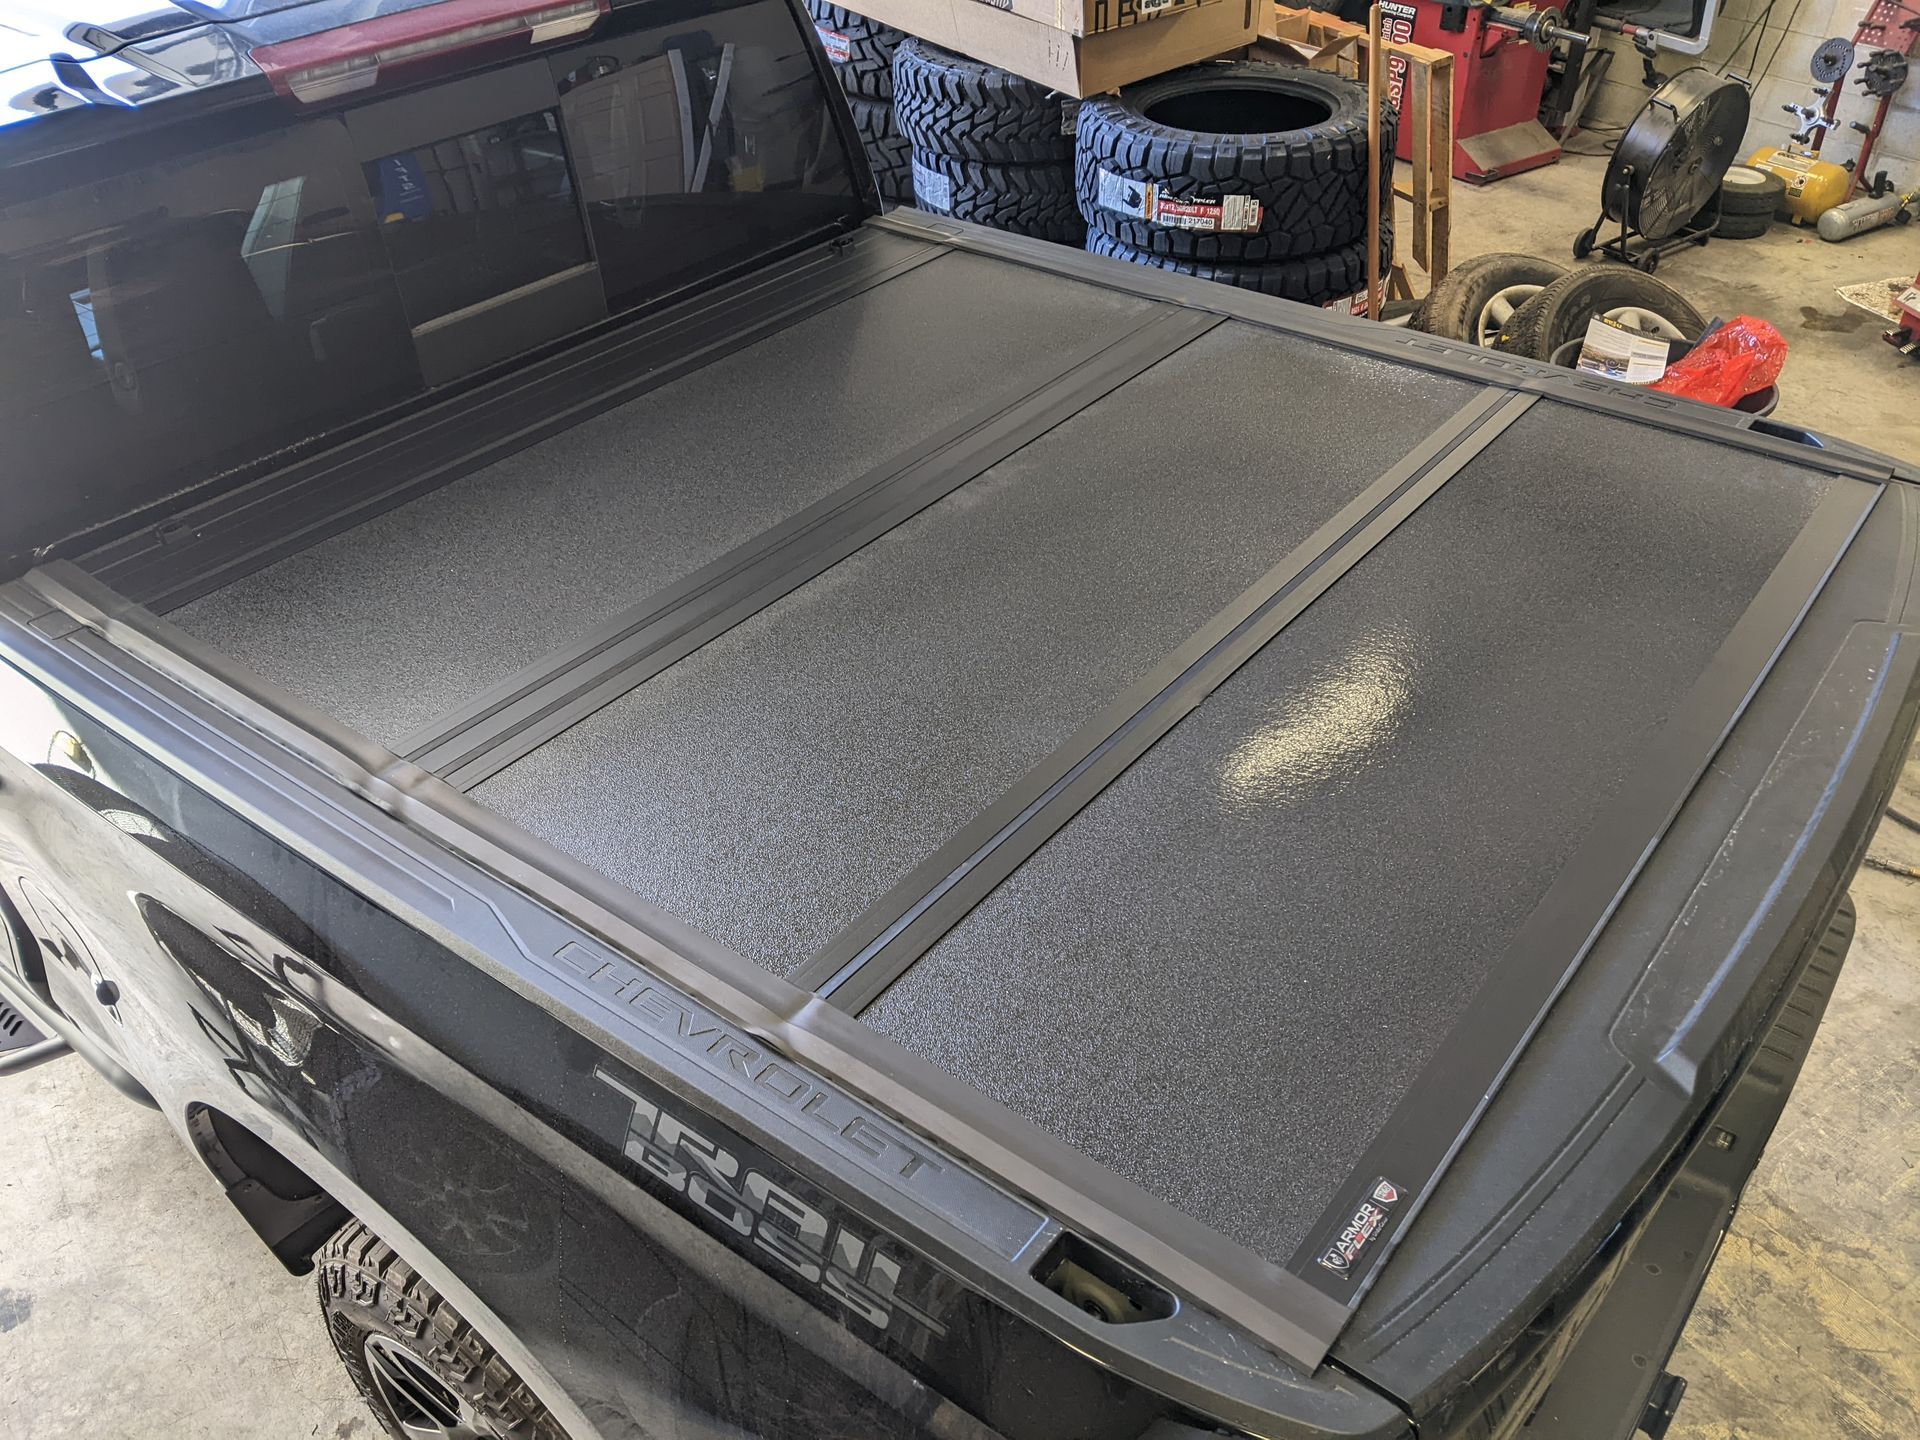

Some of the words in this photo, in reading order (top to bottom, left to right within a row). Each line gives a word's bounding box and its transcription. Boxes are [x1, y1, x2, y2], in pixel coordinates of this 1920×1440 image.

[1379, 0, 1416, 15] HUNTER
[1396, 337, 1677, 409] CHEVROLET
[553, 940, 945, 1180] CHEVROLET
[1336, 1203, 1375, 1254] ARMOR
[1344, 1206, 1383, 1262] FLEX
